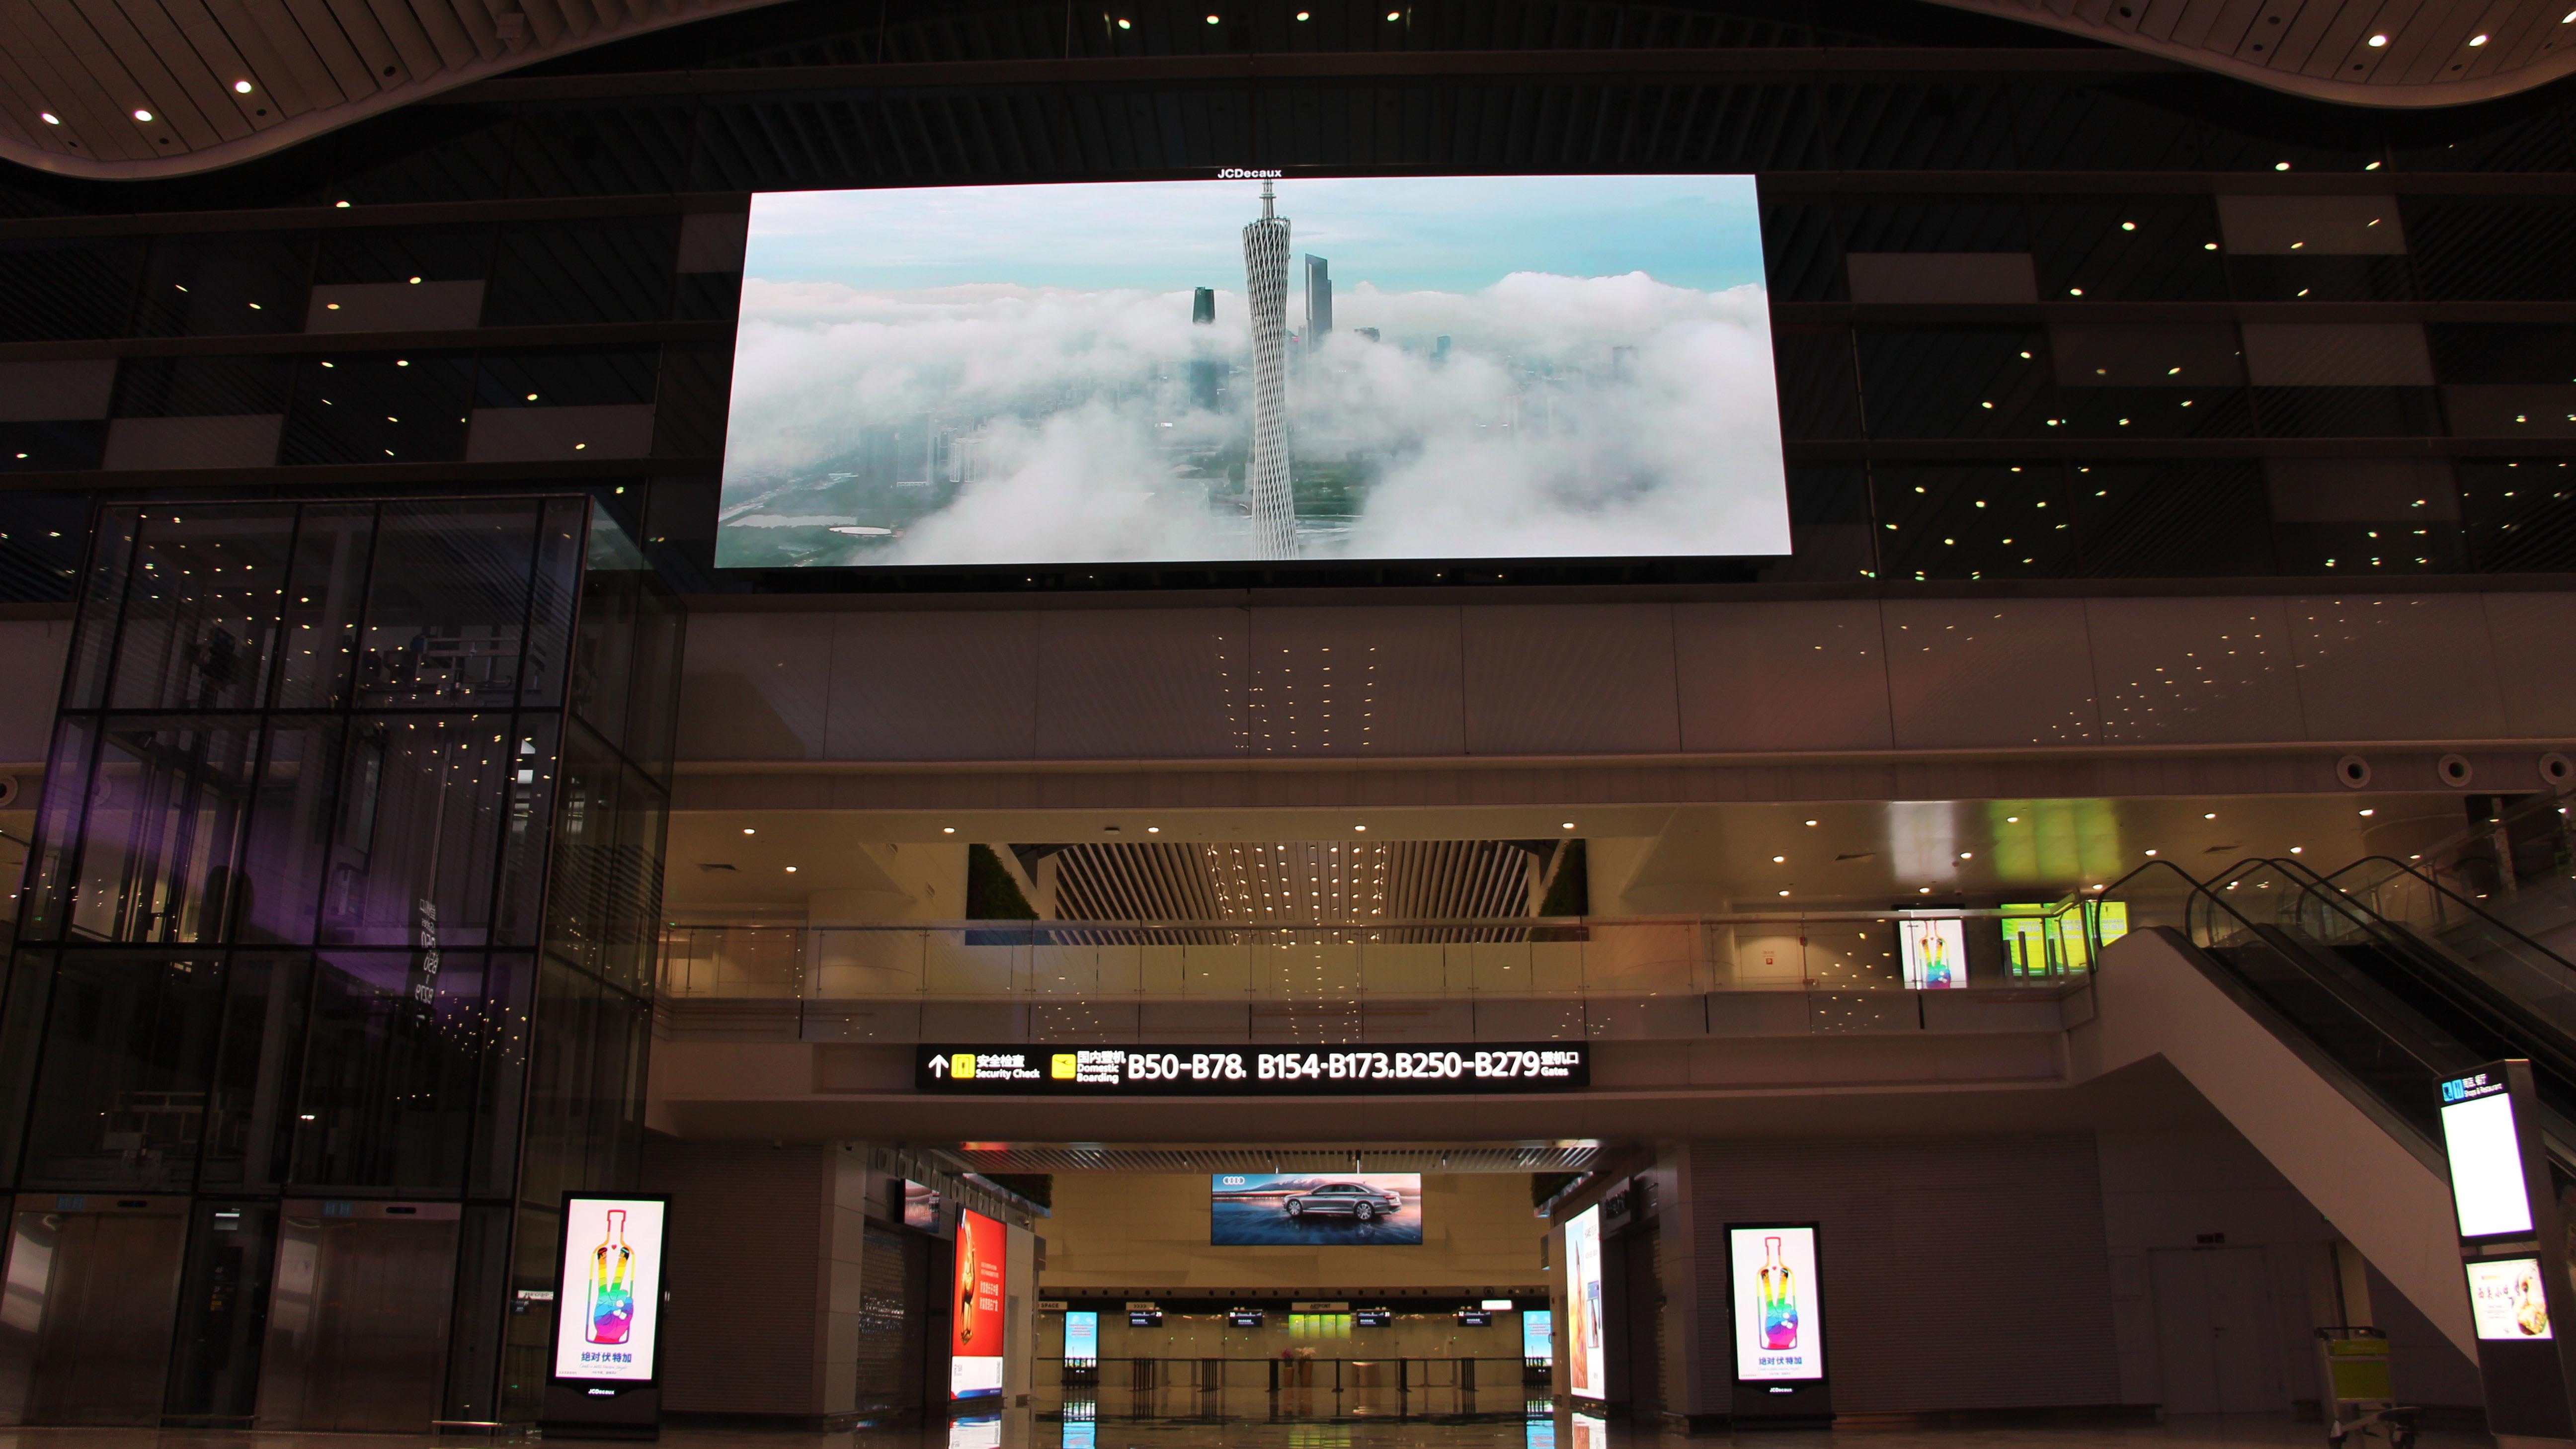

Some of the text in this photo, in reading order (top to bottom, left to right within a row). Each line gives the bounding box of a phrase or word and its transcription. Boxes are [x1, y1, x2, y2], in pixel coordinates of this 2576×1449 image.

[1217, 168, 1282, 178] JCDecaux
[976, 1054, 1025, 1068] 安全检查
[1077, 1051, 1127, 1064] 国内登机
[1541, 1051, 1579, 1065] 登机口
[1077, 1063, 1119, 1072] Domestic
[1541, 1066, 1568, 1076] Gates
[976, 1068, 1040, 1080] Security Check
[1077, 1073, 1119, 1084] Boarding
[581, 1352, 632, 1363] 绝对伏特加
[1759, 1356, 1802, 1365] 绝对伏特加
